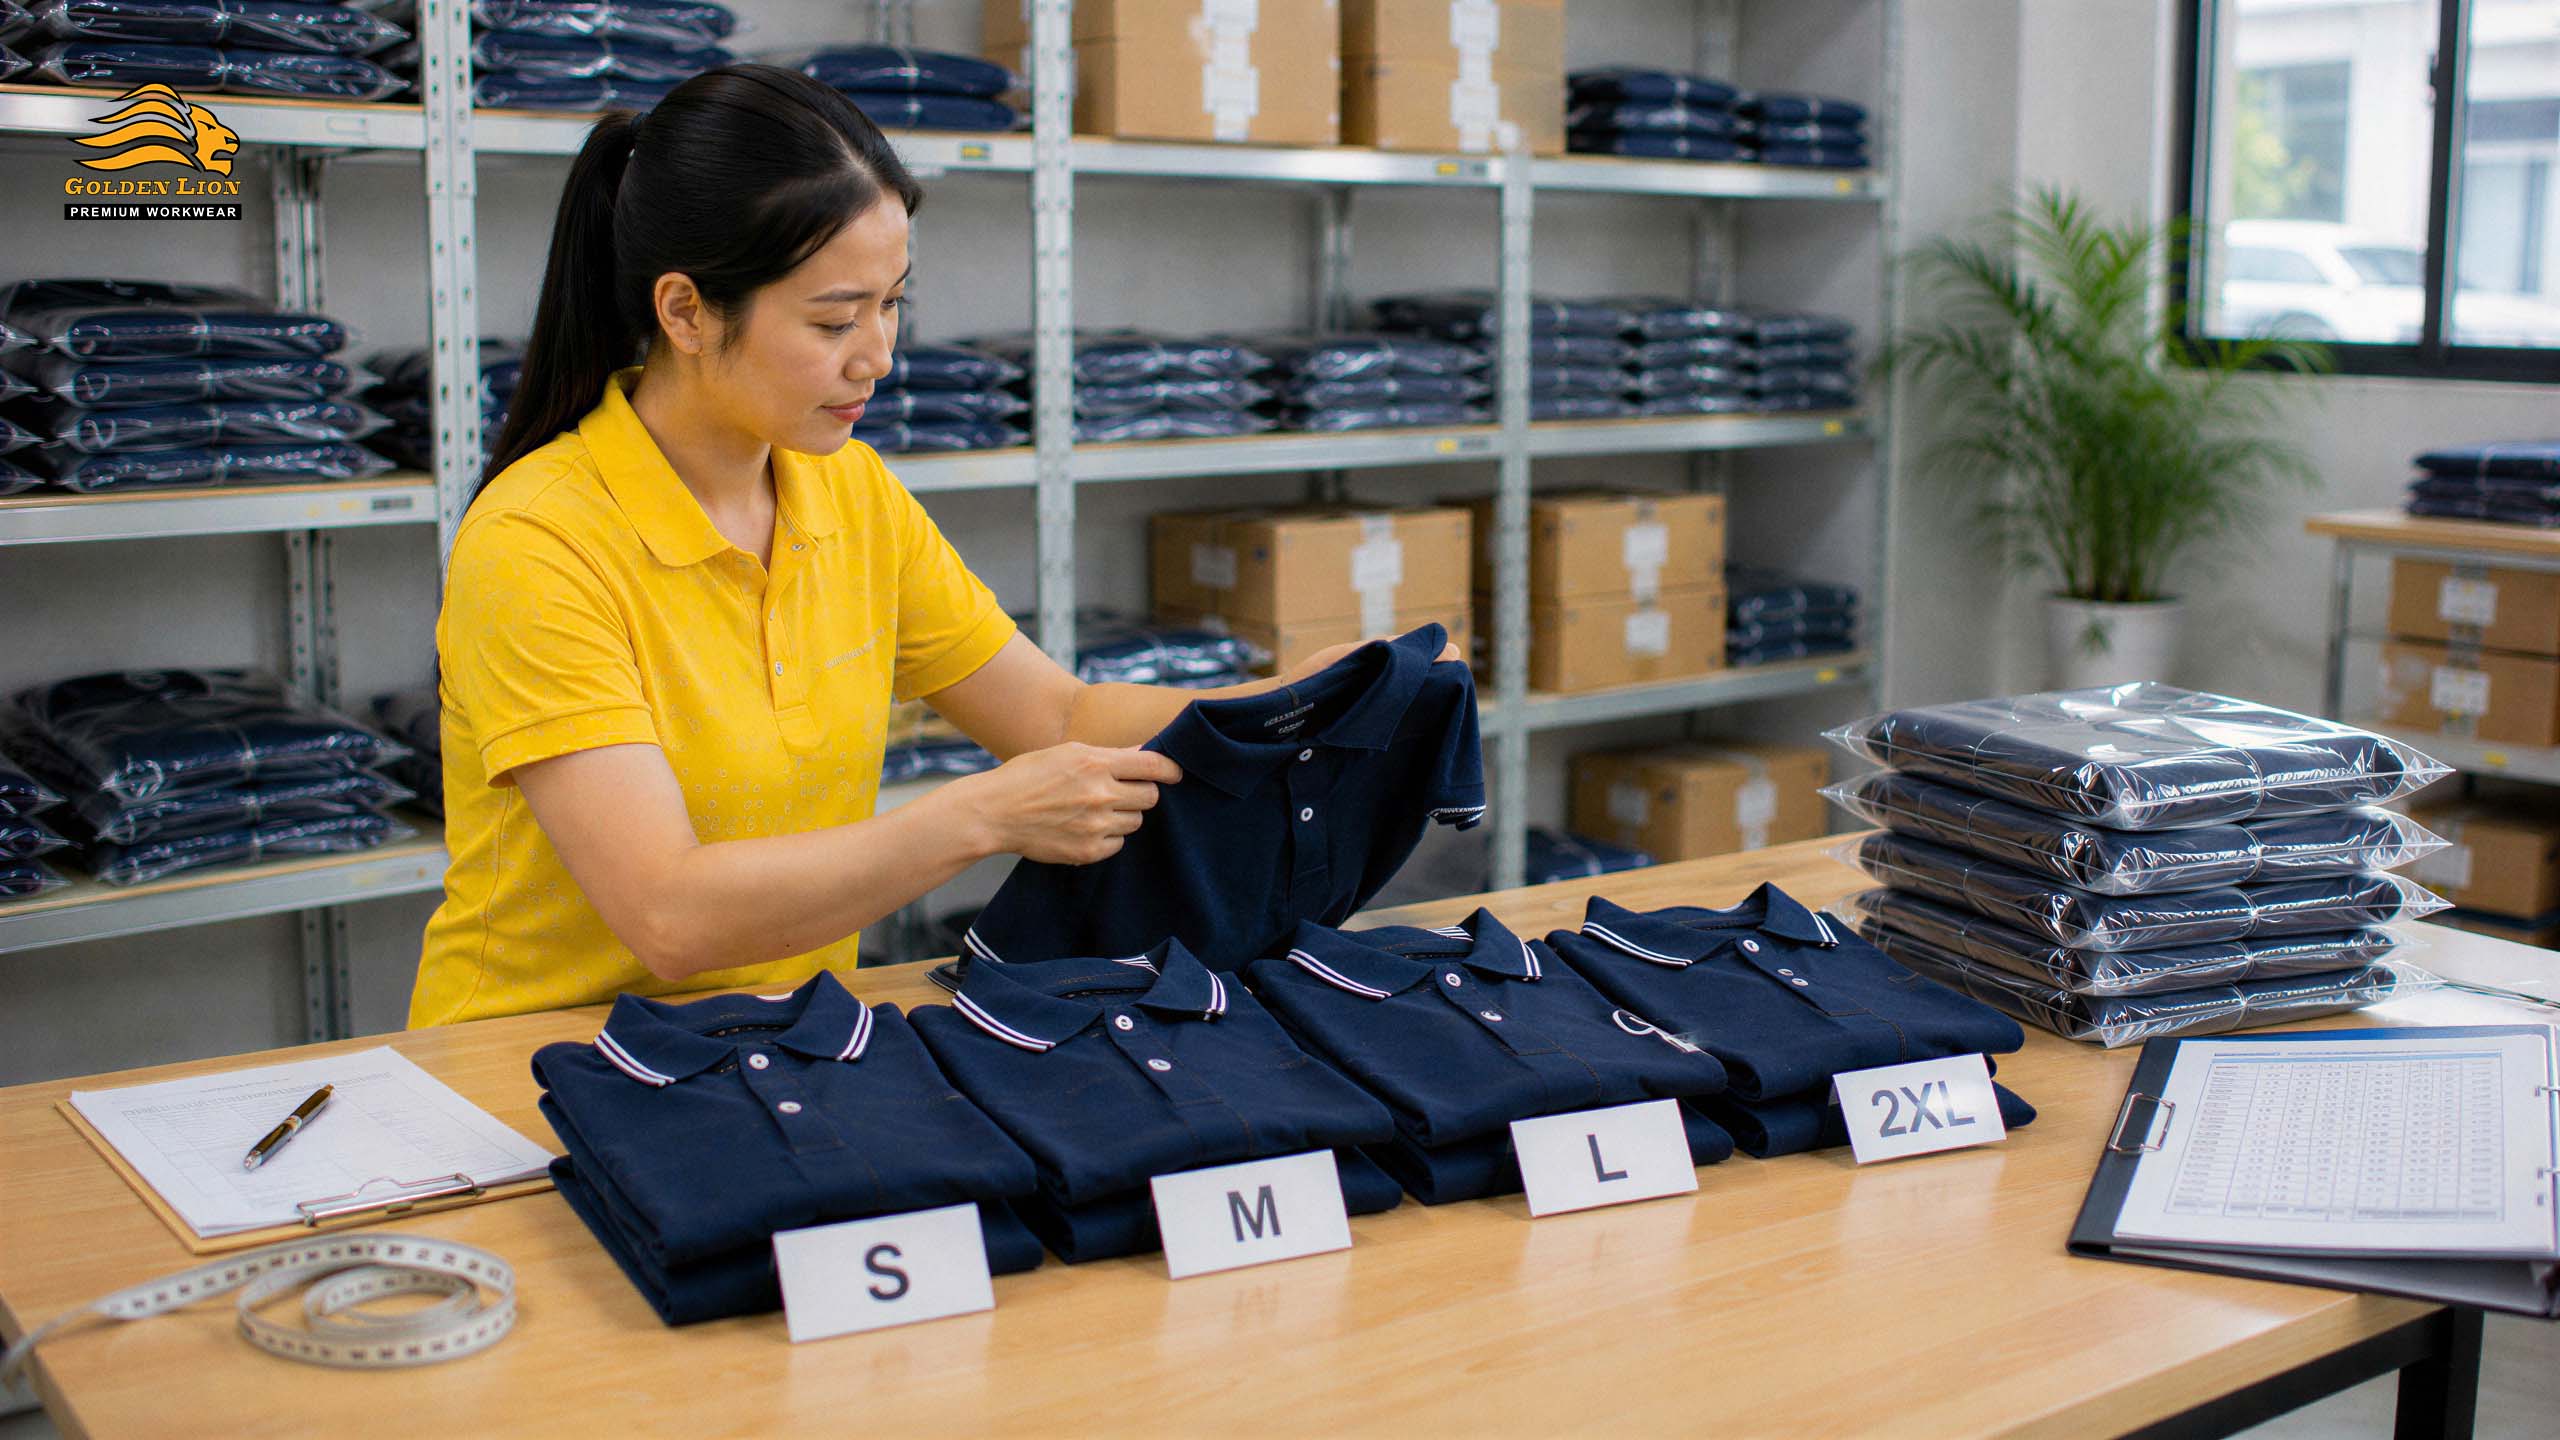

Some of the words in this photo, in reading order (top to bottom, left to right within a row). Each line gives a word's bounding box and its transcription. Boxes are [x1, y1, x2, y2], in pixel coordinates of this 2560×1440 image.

[1871, 1080, 1976, 1138] 2XL
[1587, 1133, 1628, 1183] L
[1227, 1184, 1281, 1242] M
[864, 1243, 910, 1301] S
